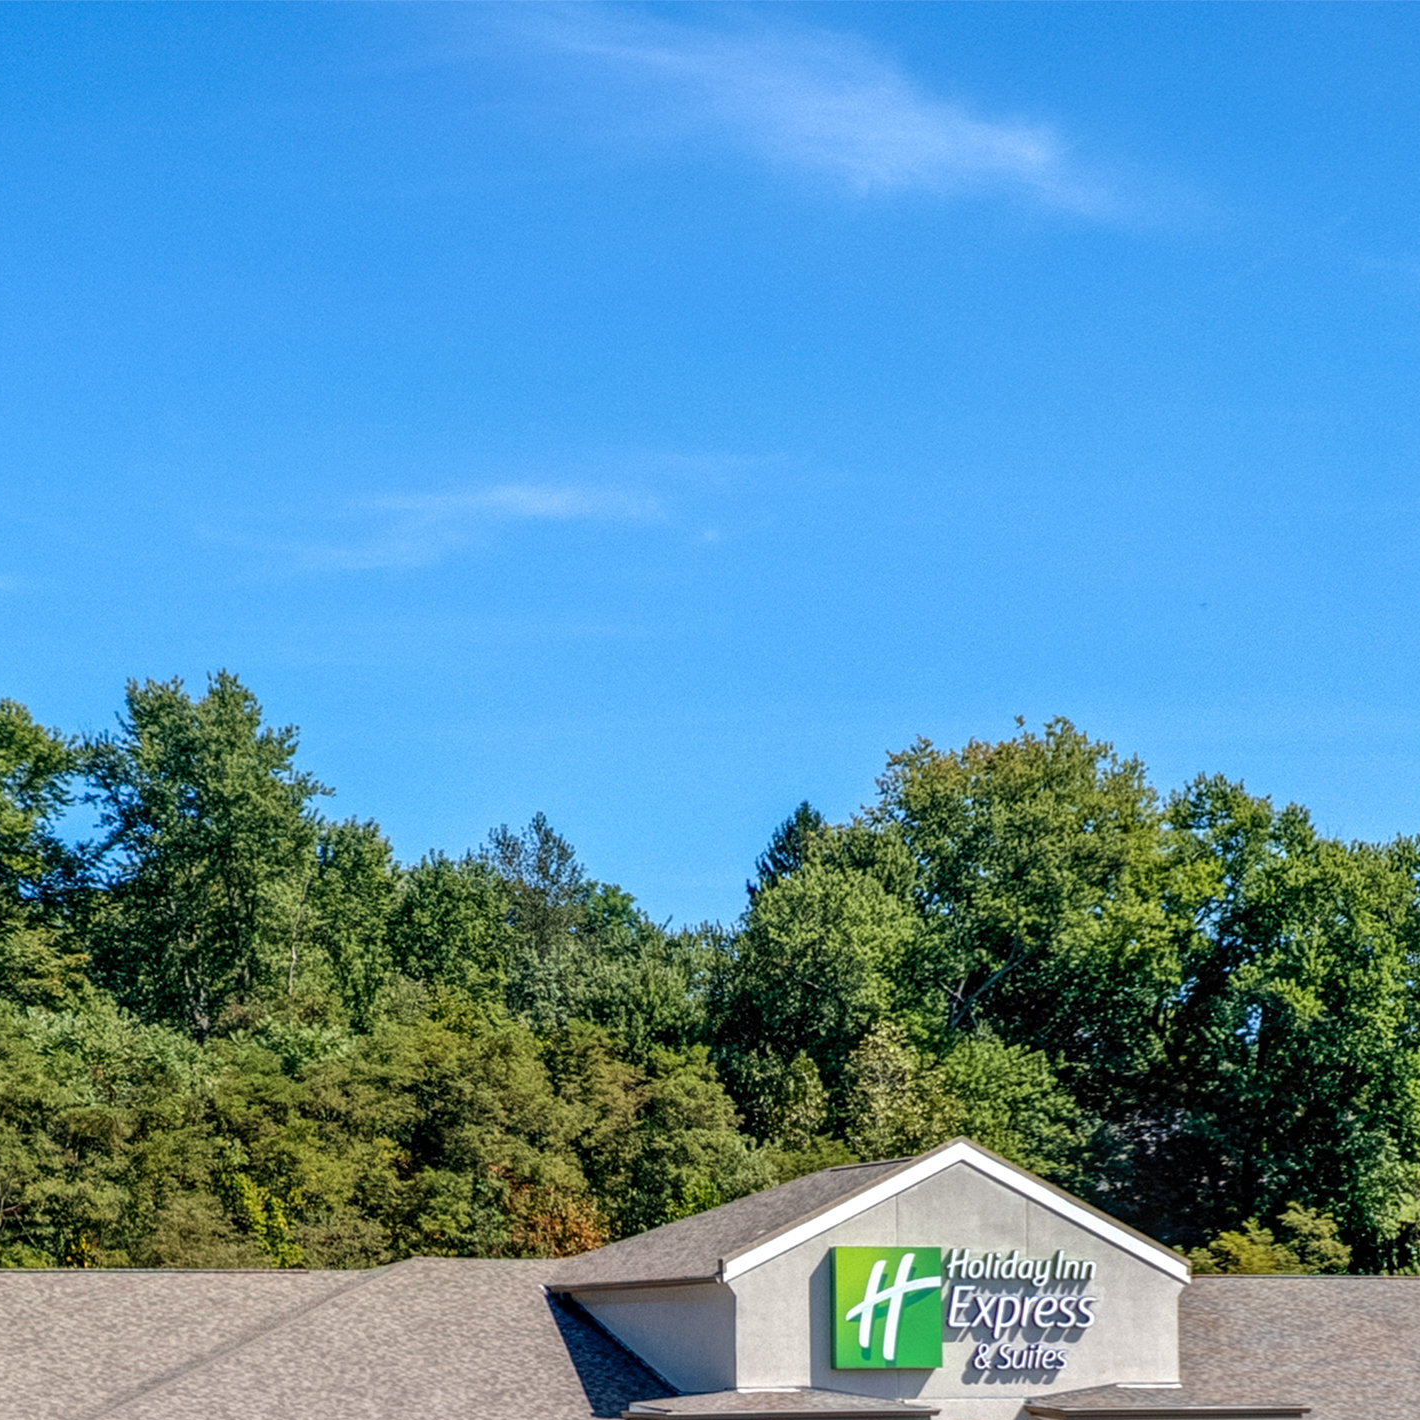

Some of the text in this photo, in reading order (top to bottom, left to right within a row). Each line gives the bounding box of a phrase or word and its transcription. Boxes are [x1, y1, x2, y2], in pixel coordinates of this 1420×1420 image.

[946, 1248, 1097, 1287] Holiday Inn
[844, 1252, 942, 1361] H
[947, 1285, 1097, 1340] Express
[973, 1343, 1068, 1370] & Suites
